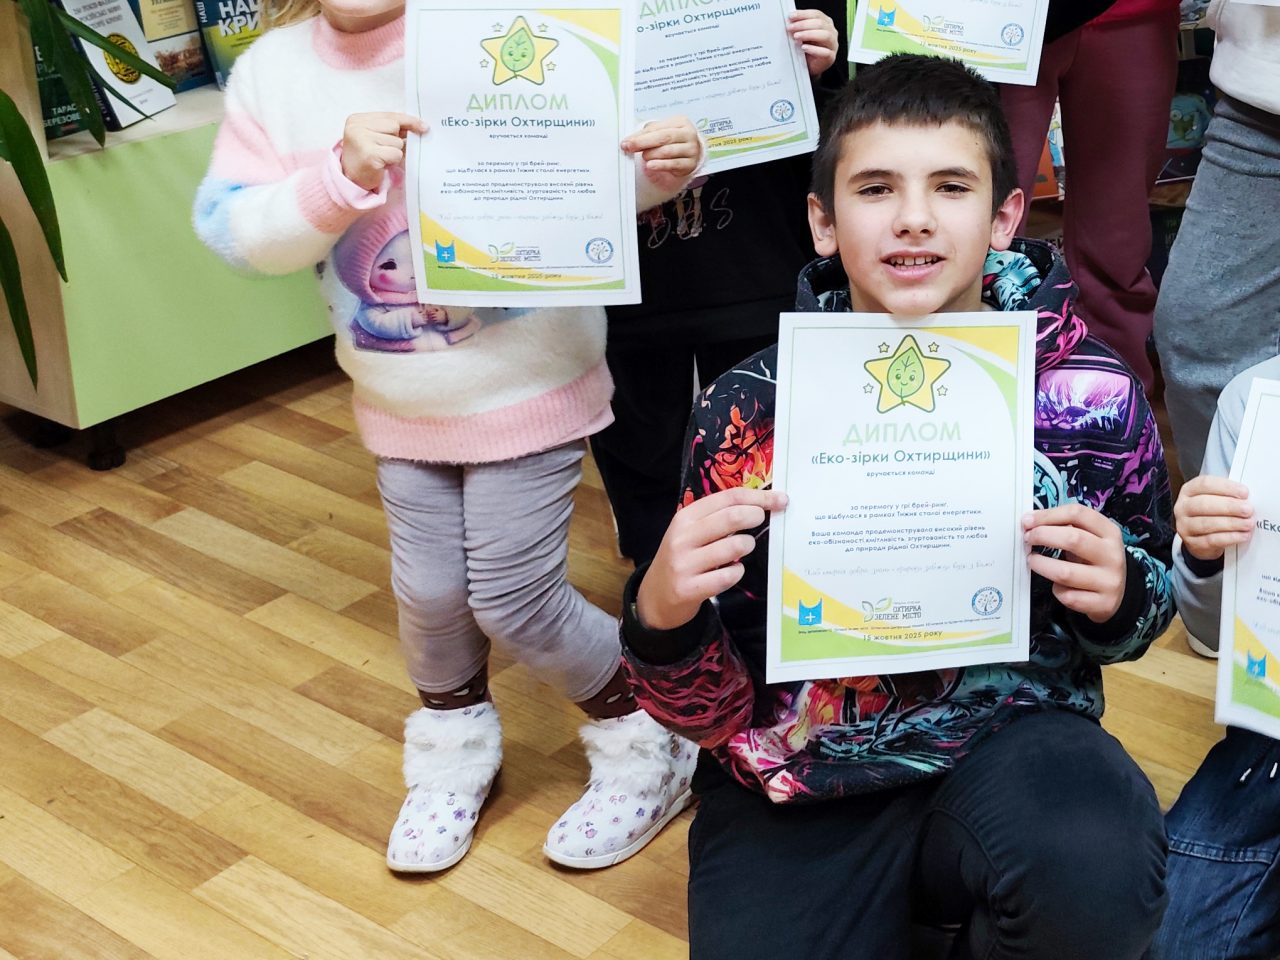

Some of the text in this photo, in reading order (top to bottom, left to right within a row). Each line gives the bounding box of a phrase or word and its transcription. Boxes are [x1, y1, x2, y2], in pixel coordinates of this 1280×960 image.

[683, 2, 761, 24] Охтирщини»
[467, 93, 569, 111] ДИПЛОМ
[52, 104, 76, 114] ТАРАС
[441, 117, 596, 129] «Еко-зірки Охтирщини»
[843, 421, 961, 446] ДИПЛОМ
[811, 449, 991, 467] «Еко-зірки Охтирщини»
[865, 527, 932, 535] продемонструвала
[893, 605, 922, 613] ОХТИРКА
[874, 611, 922, 621] ЗЕЛЕНЕ МІСТО
[873, 633, 902, 641] жовтня
[904, 632, 922, 640] 2025
[923, 630, 943, 640] року
